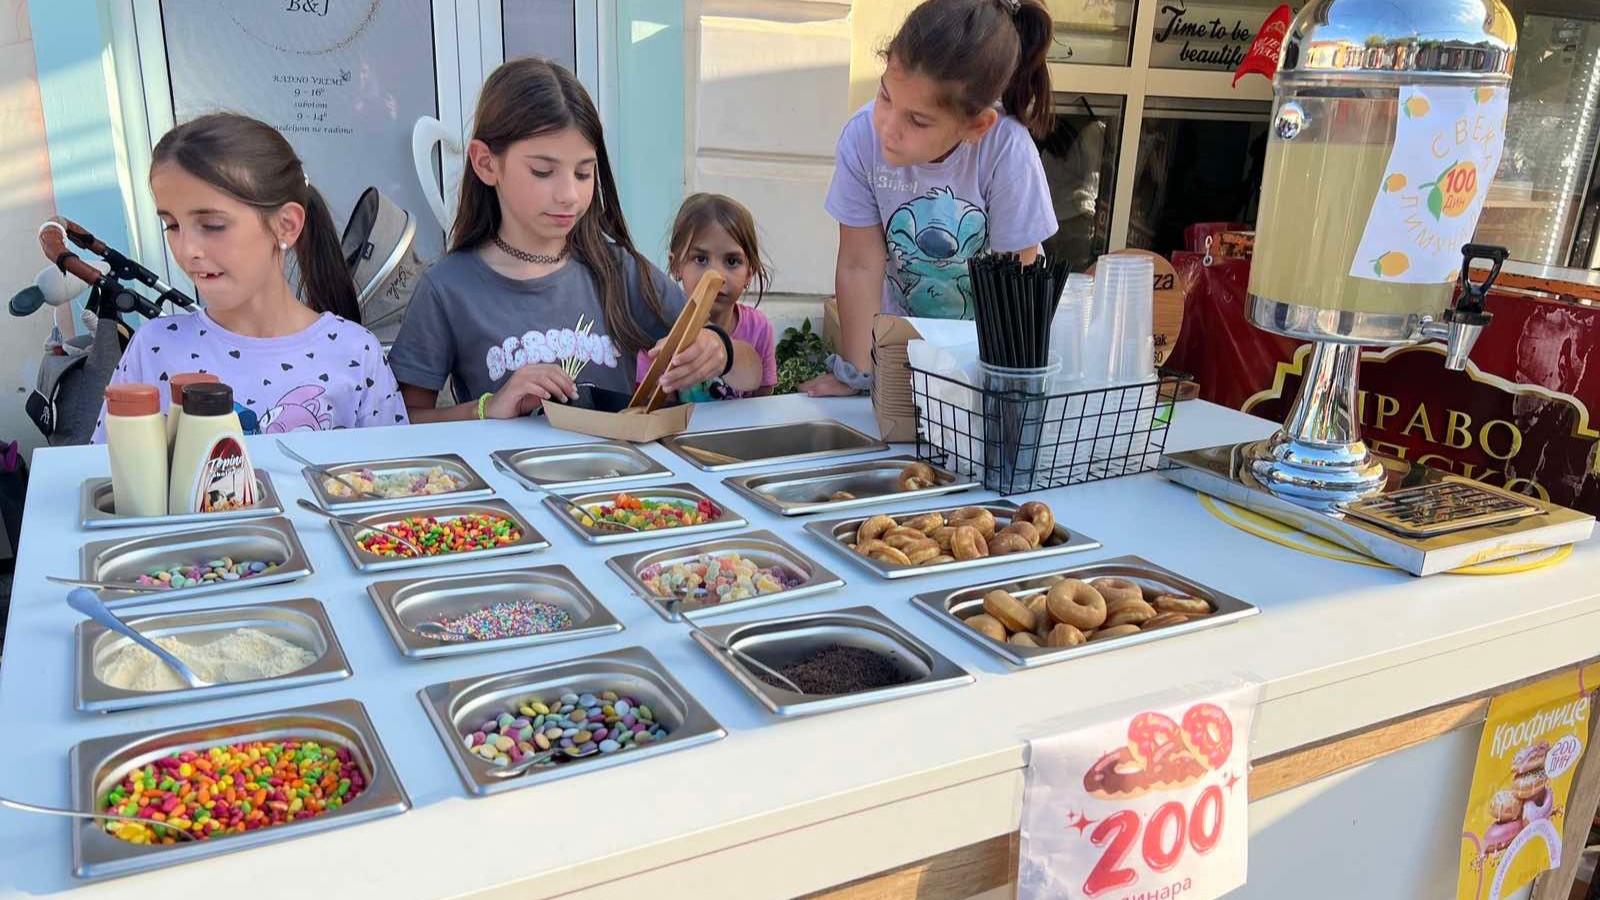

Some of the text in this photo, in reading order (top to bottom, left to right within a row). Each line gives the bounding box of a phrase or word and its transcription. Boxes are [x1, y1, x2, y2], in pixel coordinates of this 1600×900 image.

[1155, 5, 1251, 42] Time to be
[1180, 41, 1248, 69] beautifu
[1446, 168, 1476, 193] 100
[1490, 697, 1588, 759] Крофнице
[1551, 739, 1577, 756] 200
[1082, 784, 1226, 898] 200
